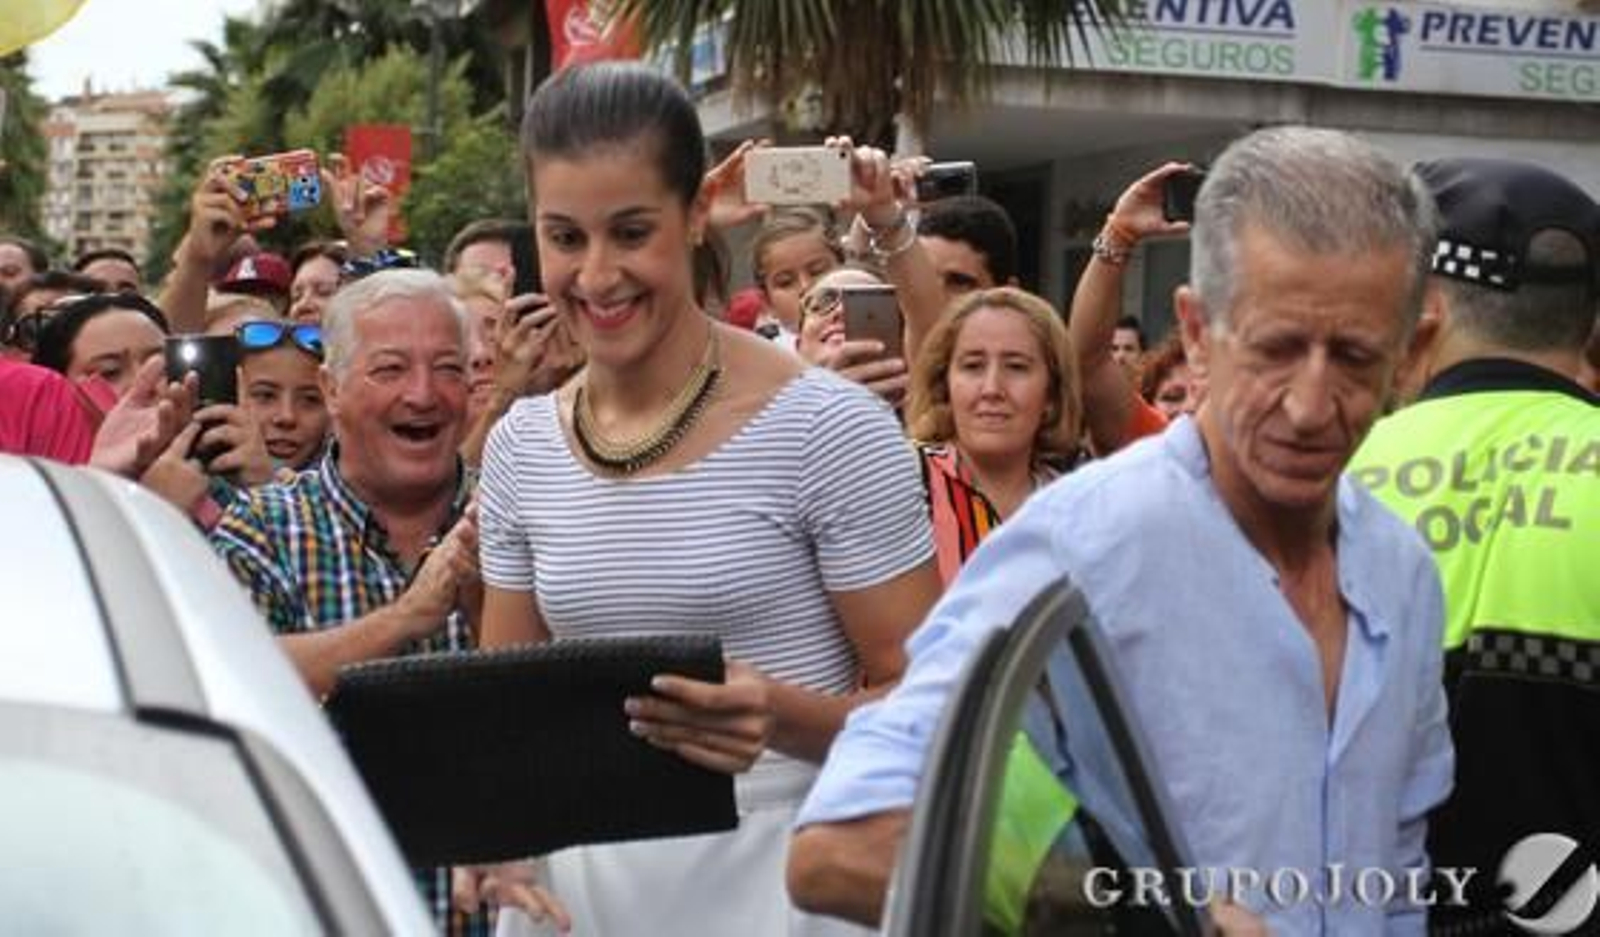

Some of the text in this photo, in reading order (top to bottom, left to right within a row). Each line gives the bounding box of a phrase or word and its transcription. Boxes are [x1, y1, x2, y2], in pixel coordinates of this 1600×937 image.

[1074, 0, 1296, 29] ENTIVA
[1108, 33, 1296, 75] SEGUROS
[1415, 483, 1573, 553] OCAL
